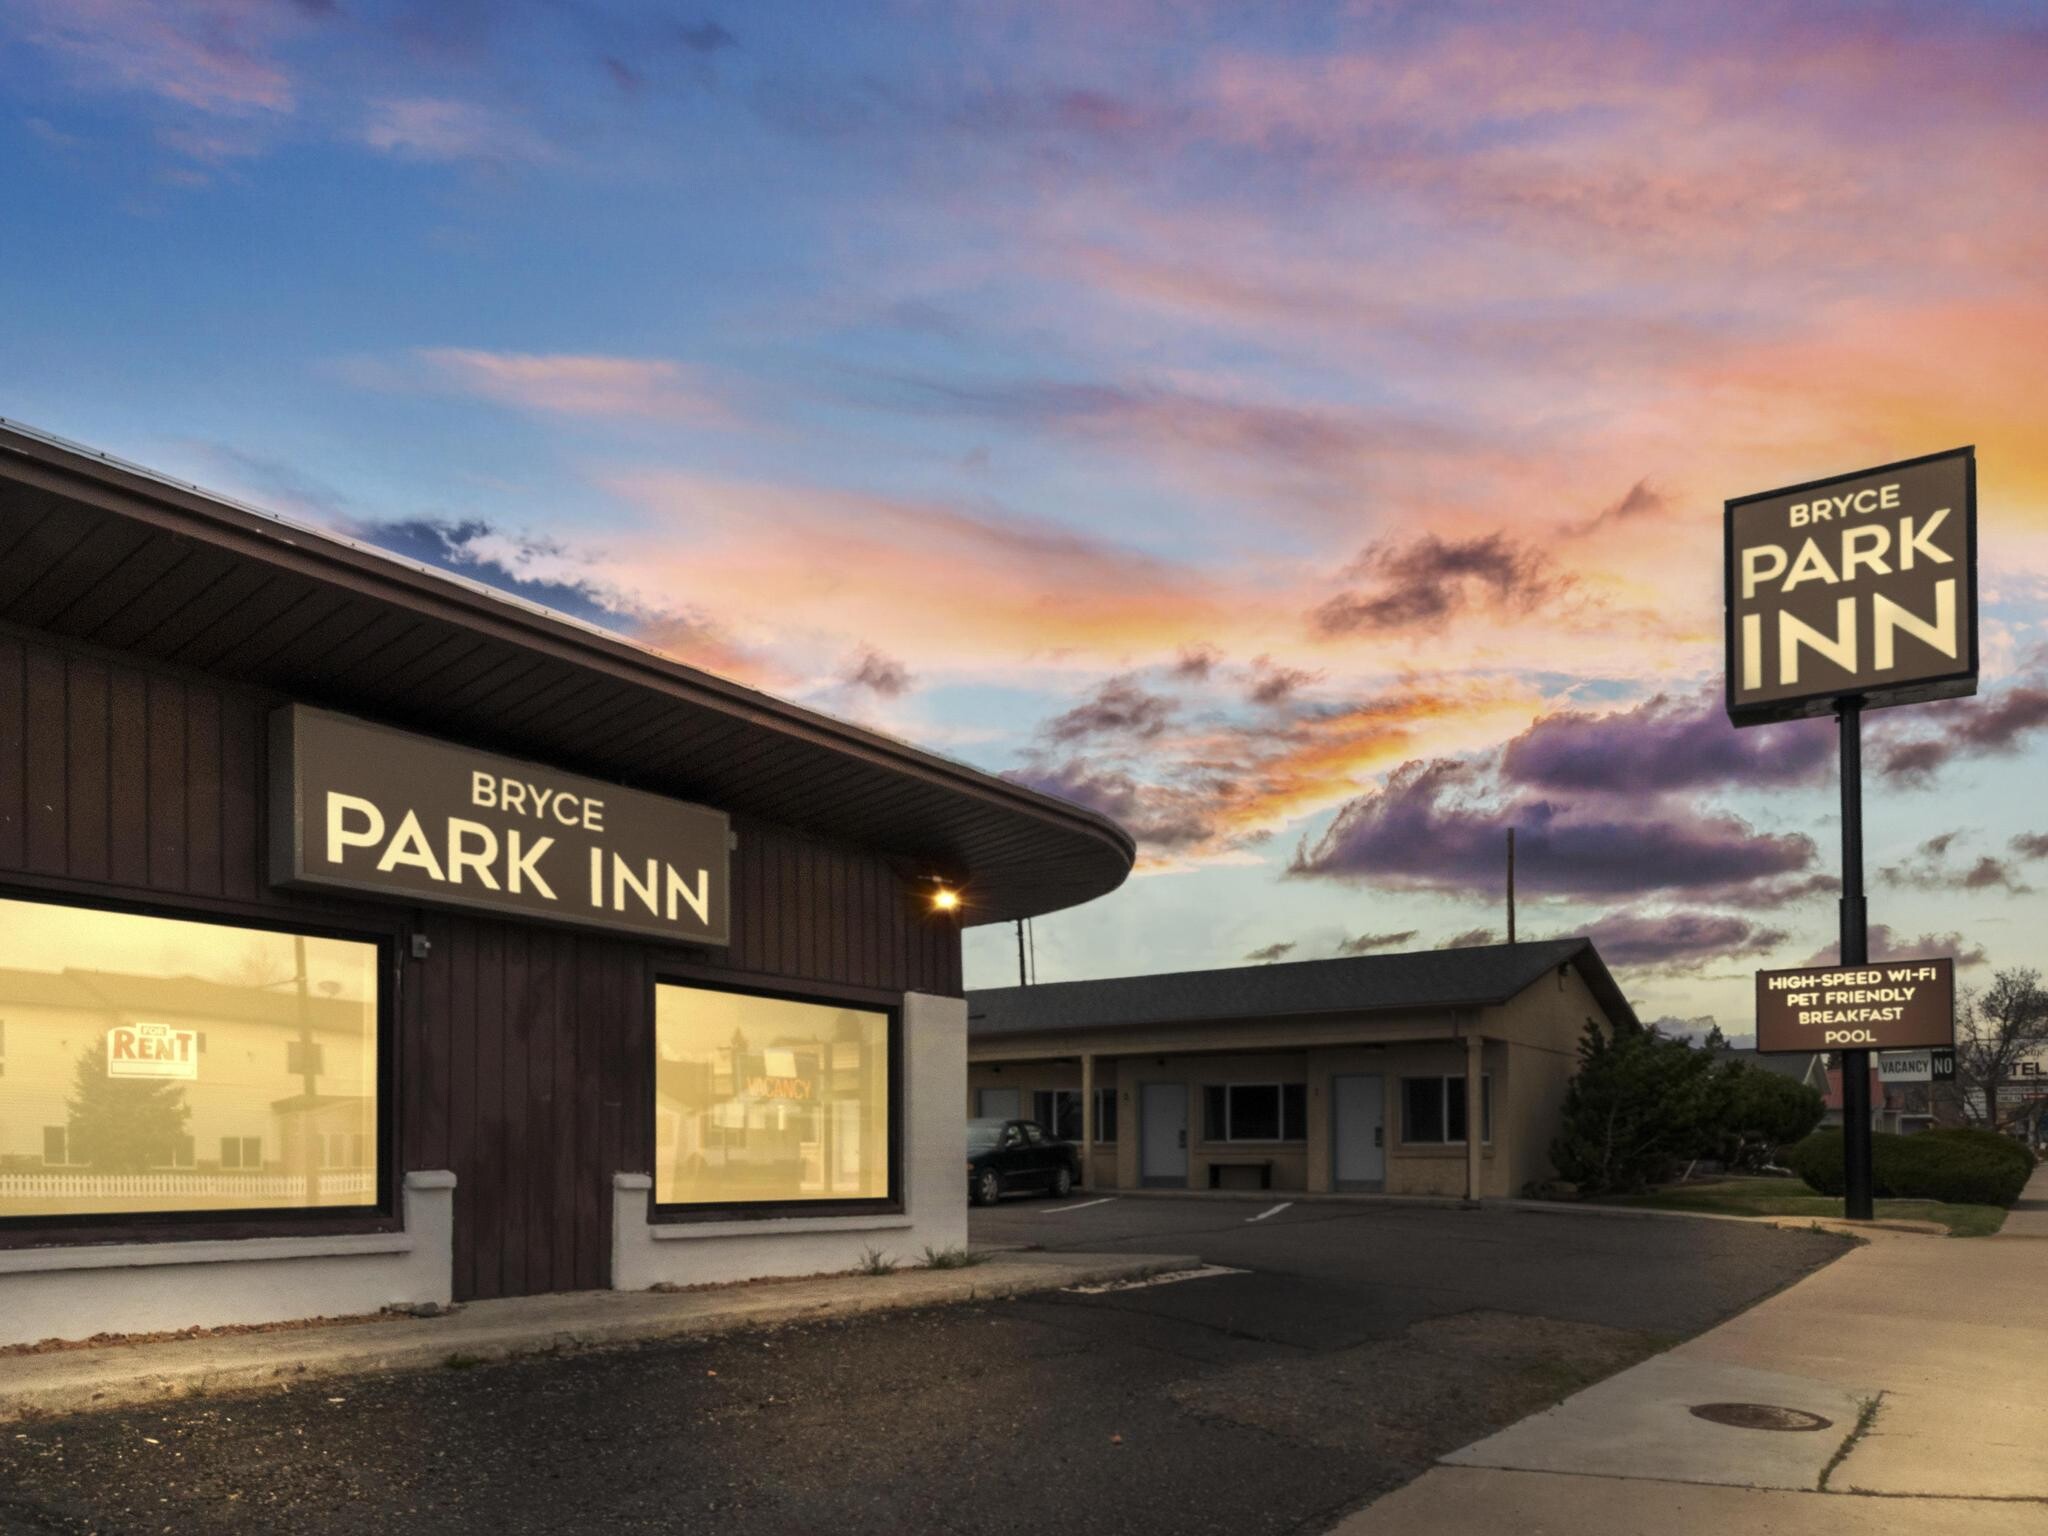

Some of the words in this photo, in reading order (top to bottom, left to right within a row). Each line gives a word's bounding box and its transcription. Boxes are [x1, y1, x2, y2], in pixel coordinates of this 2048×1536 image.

[1790, 484, 1900, 528] BRYCE
[1742, 508, 1954, 599] PARK
[1742, 578, 1957, 690] INN
[472, 771, 604, 832] BRYCE
[326, 791, 558, 900] PARK
[590, 847, 709, 926] INN
[1768, 971, 1882, 990] HIGH-SPEED
[1887, 967, 1937, 983] WI-FI
[1787, 992, 1820, 1007] PET
[1825, 987, 1916, 1005] FRIENDLY
[1798, 1007, 1904, 1025] BREAKFAST
[113, 1029, 193, 1062] RENT
[1825, 1029, 1877, 1044] POOL
[1880, 1059, 1930, 1075] VACANCY
[1933, 1057, 1954, 1075] NO
[747, 1077, 812, 1100] VACANCY
